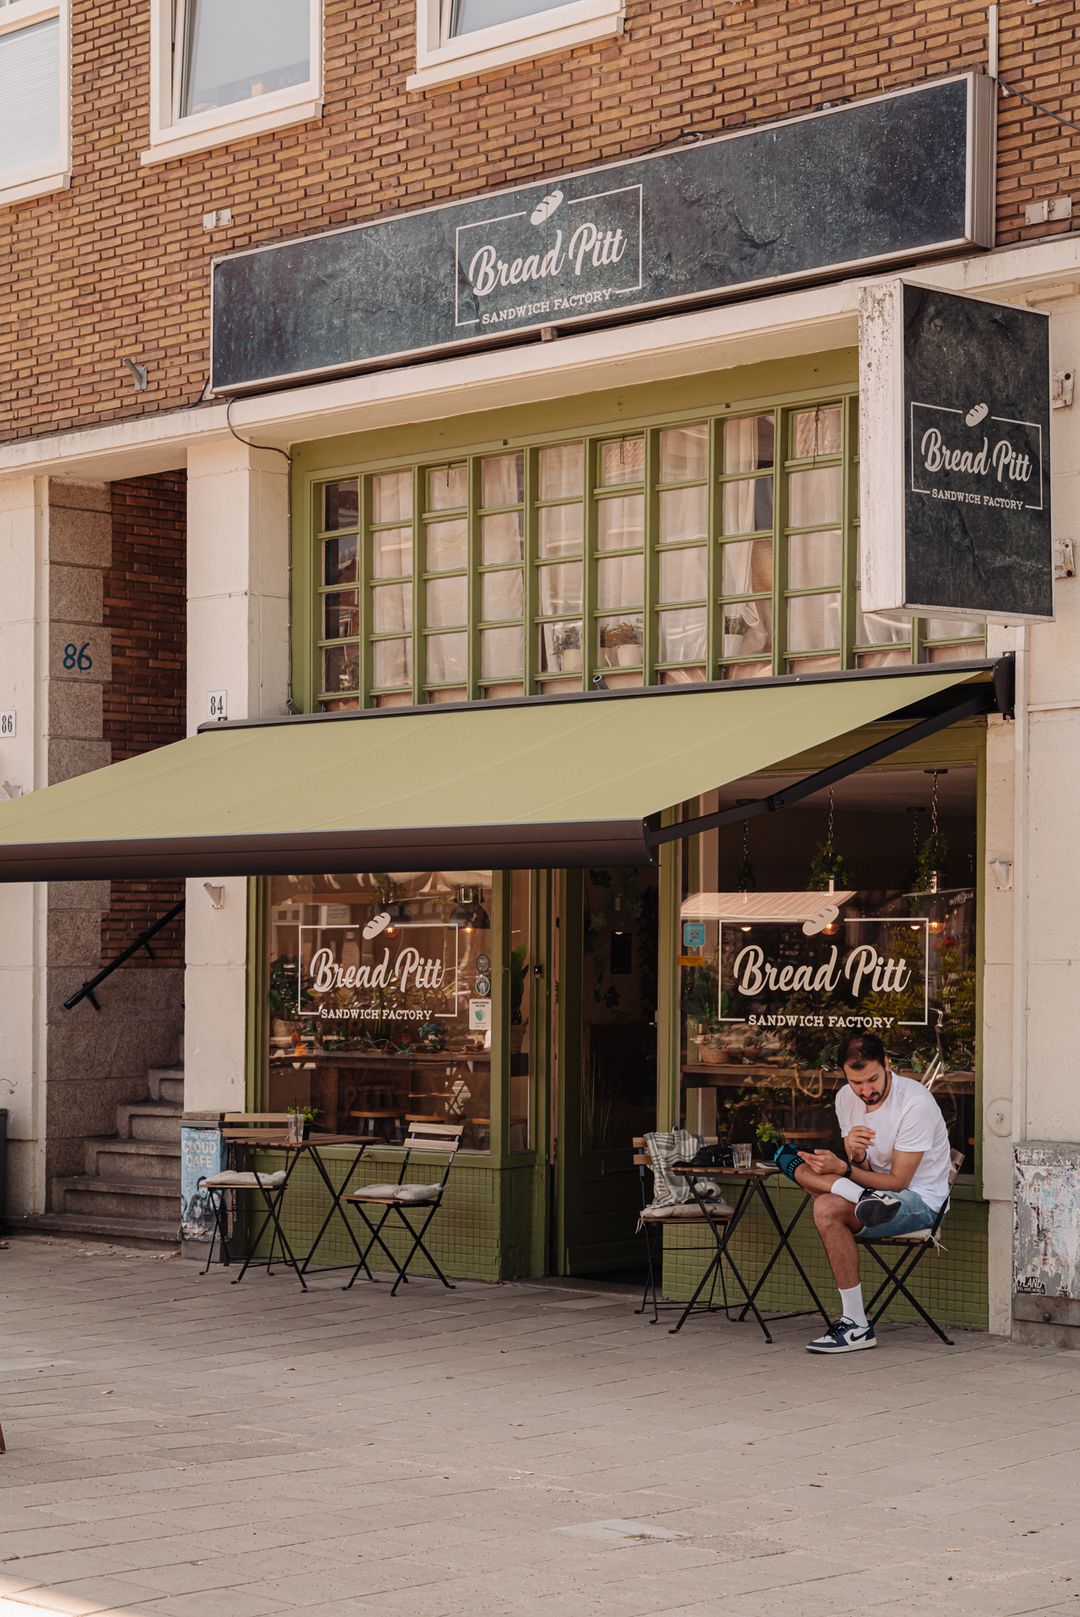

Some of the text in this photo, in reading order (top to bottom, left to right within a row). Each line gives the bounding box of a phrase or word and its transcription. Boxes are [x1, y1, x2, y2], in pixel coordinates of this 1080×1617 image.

[468, 222, 628, 297] Bread Pitt
[482, 288, 613, 325] SANDWICH FACTORY
[920, 427, 1033, 483] Bread Pitt
[931, 488, 1024, 511] SANDWICH FACTORY
[62, 642, 94, 671] 86
[210, 695, 224, 716] 84
[1, 714, 13, 734] 86
[309, 947, 393, 993] Bread
[394, 946, 446, 994] Pitt
[733, 944, 912, 998] Bread Pitt
[321, 1008, 433, 1021] SANDWICH FACTORY
[748, 1014, 895, 1029] SANDWICH FACTORY
[182, 1141, 217, 1154] CLOUD
